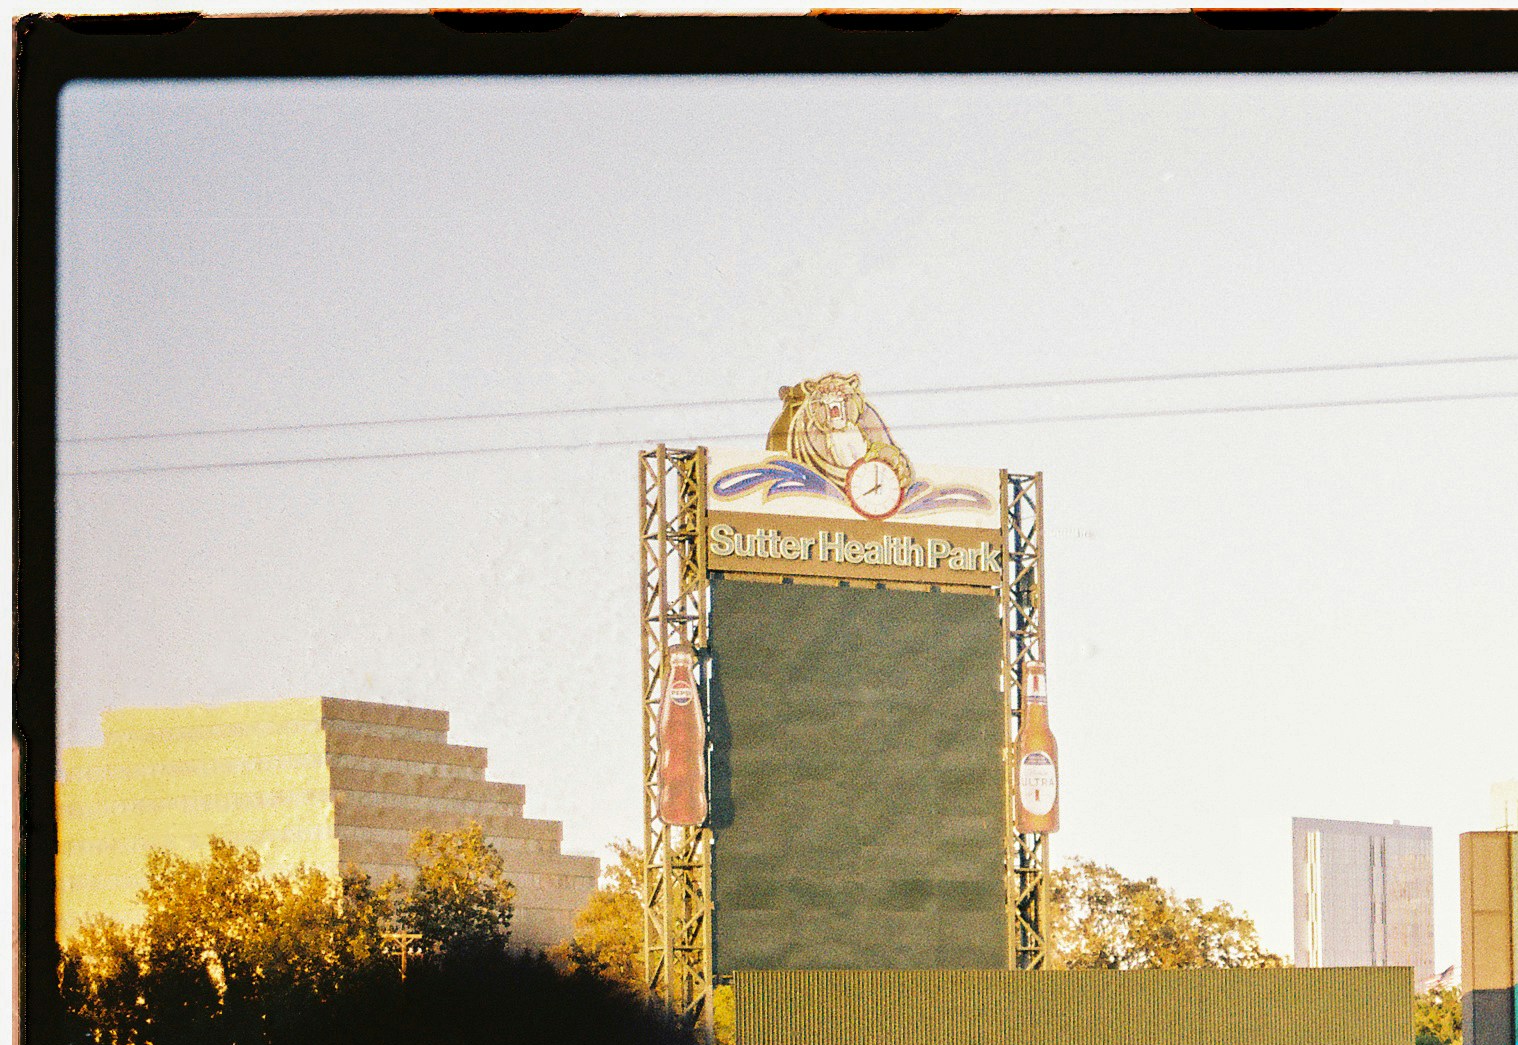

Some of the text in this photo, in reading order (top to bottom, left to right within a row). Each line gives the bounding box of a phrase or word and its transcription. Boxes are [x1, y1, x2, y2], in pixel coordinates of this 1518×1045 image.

[710, 523, 1002, 573] Sutter Health Park
